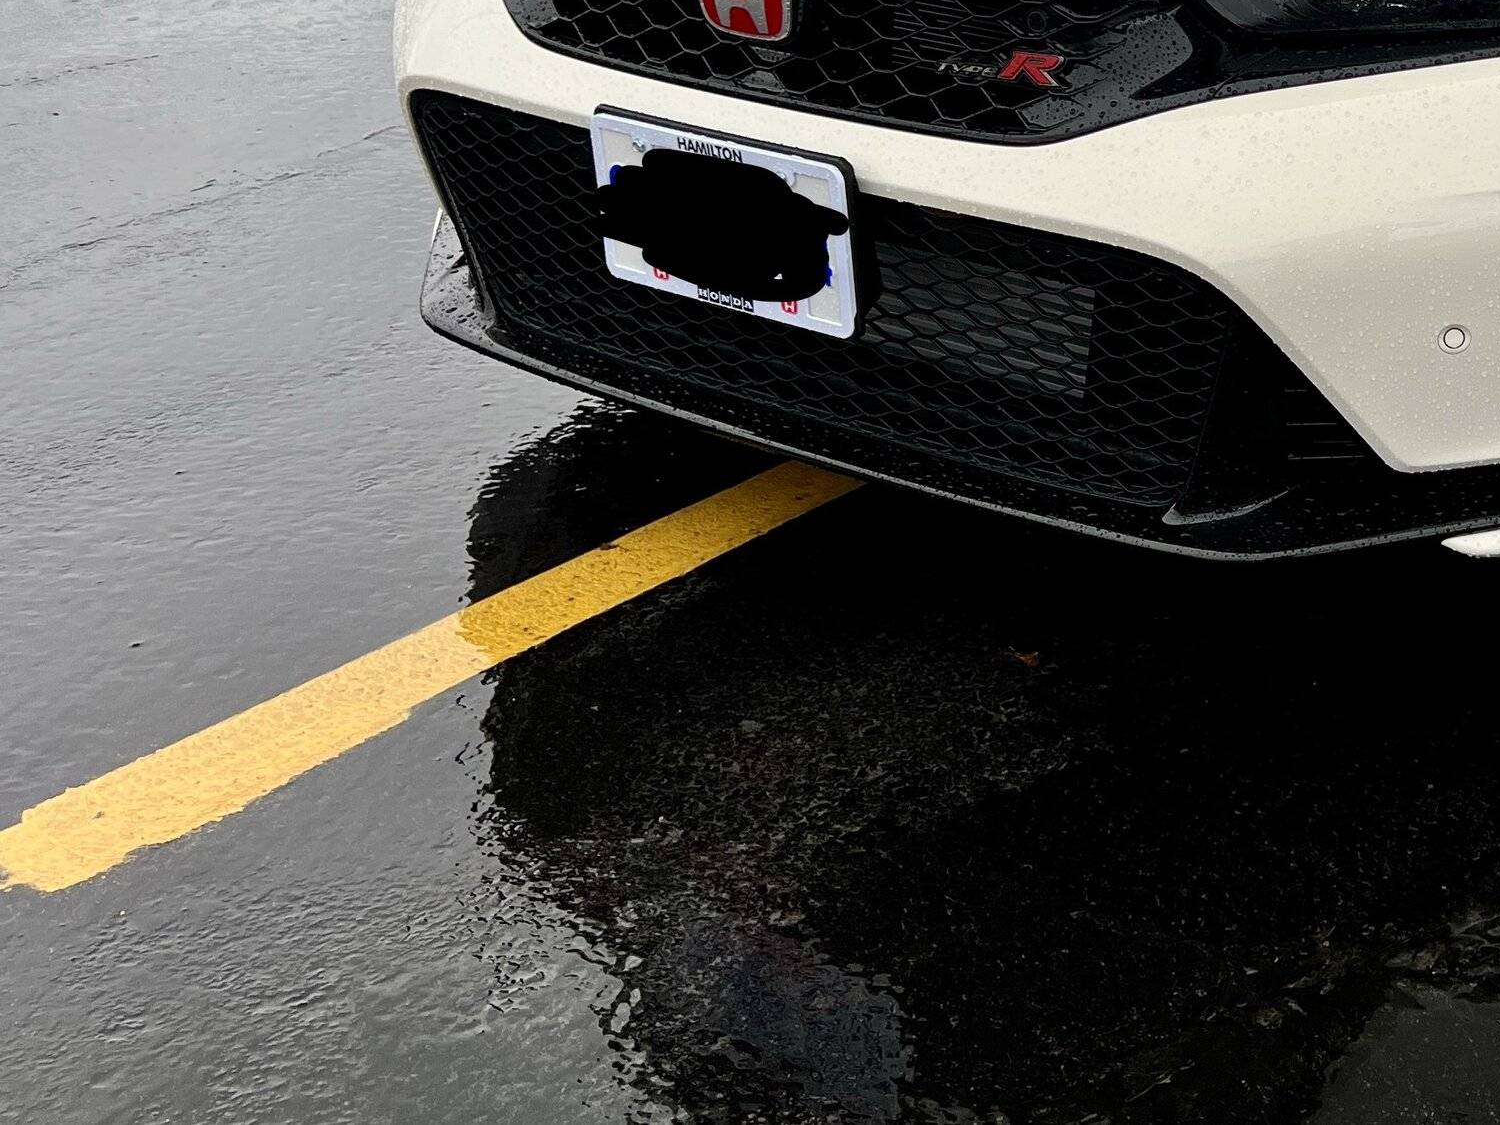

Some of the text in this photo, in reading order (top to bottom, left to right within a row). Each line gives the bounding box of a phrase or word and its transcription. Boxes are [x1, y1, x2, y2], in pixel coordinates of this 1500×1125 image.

[997, 50, 1065, 87] R
[677, 135, 743, 164] HAMILTON
[697, 287, 754, 310] HONDA
